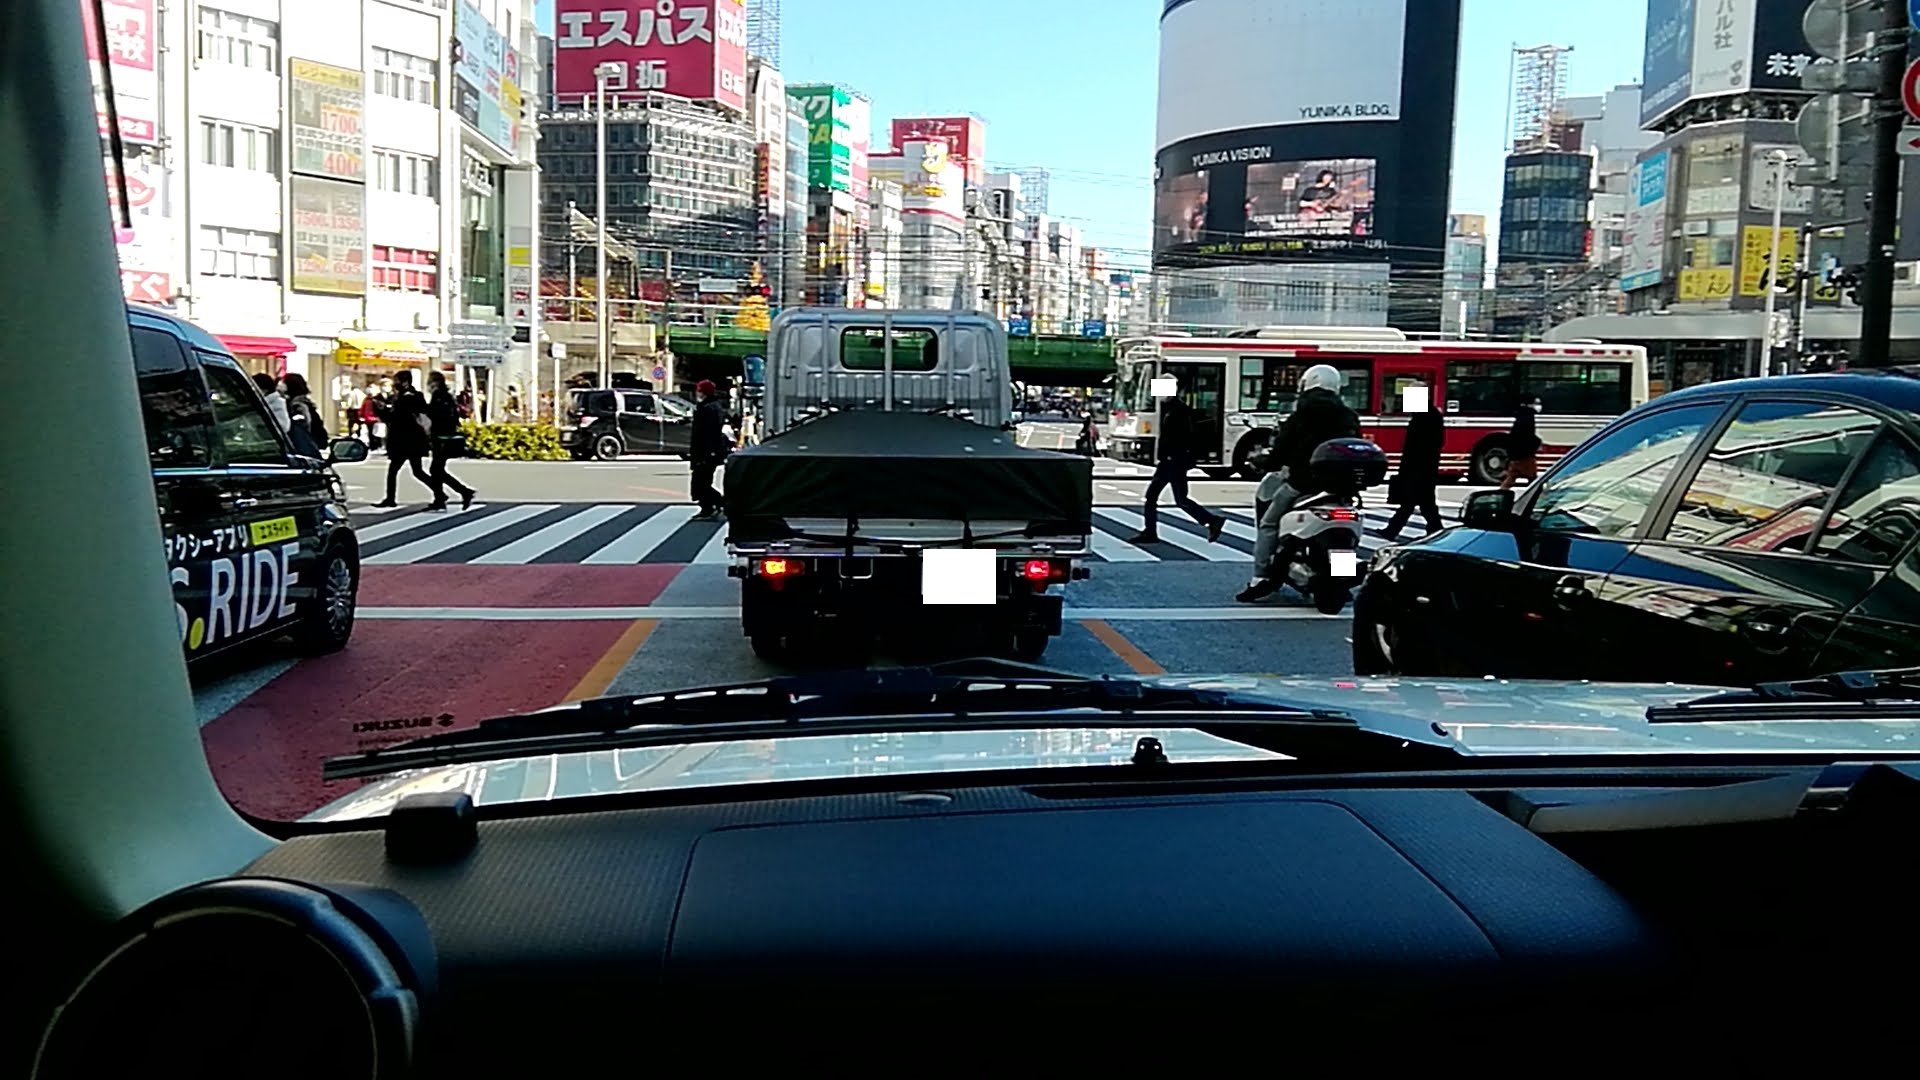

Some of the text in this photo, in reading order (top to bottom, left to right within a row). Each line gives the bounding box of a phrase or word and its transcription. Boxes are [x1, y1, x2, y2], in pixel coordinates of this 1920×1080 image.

[558, 0, 712, 48] エスパス
[1299, 105, 1352, 118] YUNIKA
[1192, 147, 1272, 167] YUNIKA VISION
